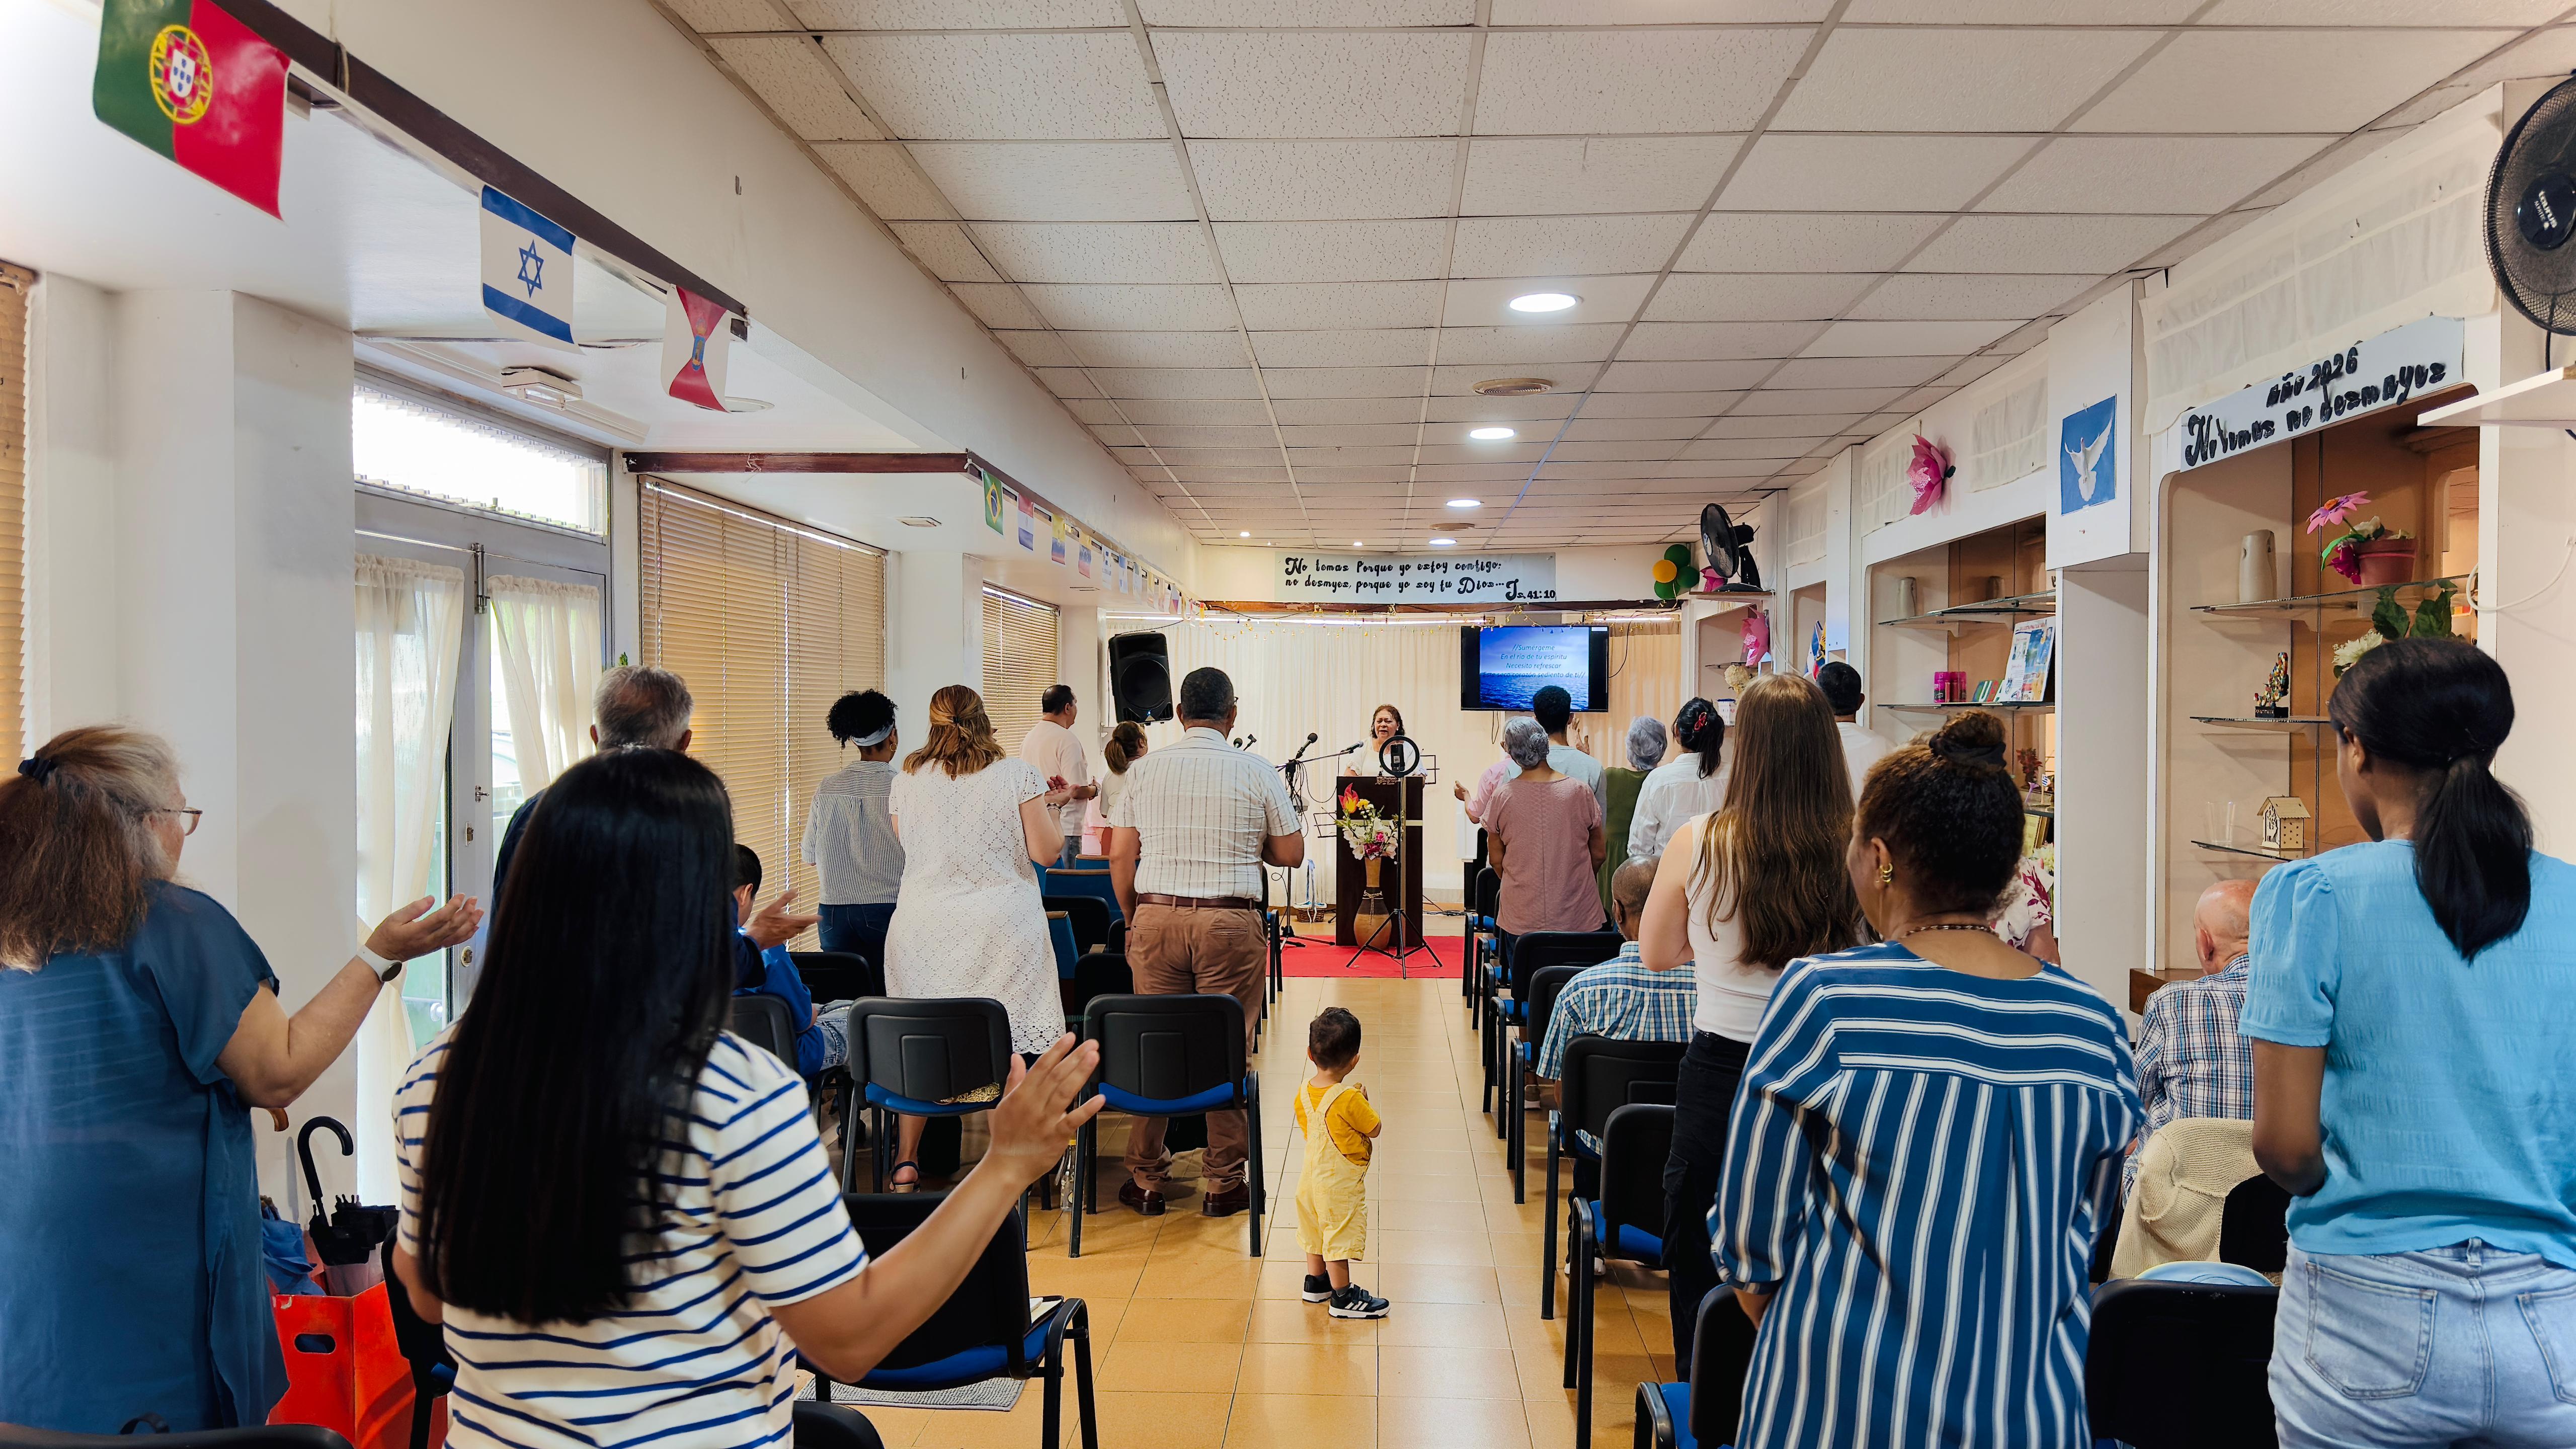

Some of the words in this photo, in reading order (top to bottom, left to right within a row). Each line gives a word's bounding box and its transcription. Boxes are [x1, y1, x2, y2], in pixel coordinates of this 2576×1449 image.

[2304, 346, 2358, 392] 2026
[2185, 414, 2217, 466] No
[2286, 406, 2313, 432] no
[1285, 557, 1308, 576] No
[1316, 559, 1349, 572] temas
[1356, 560, 1393, 577] Porque
[1399, 564, 1411, 576] yo
[1417, 560, 1448, 574] estoy
[1356, 581, 1392, 594] porque
[1398, 581, 1410, 593] yo
[1416, 582, 1434, 593] soy
[1440, 580, 1452, 592] tu
